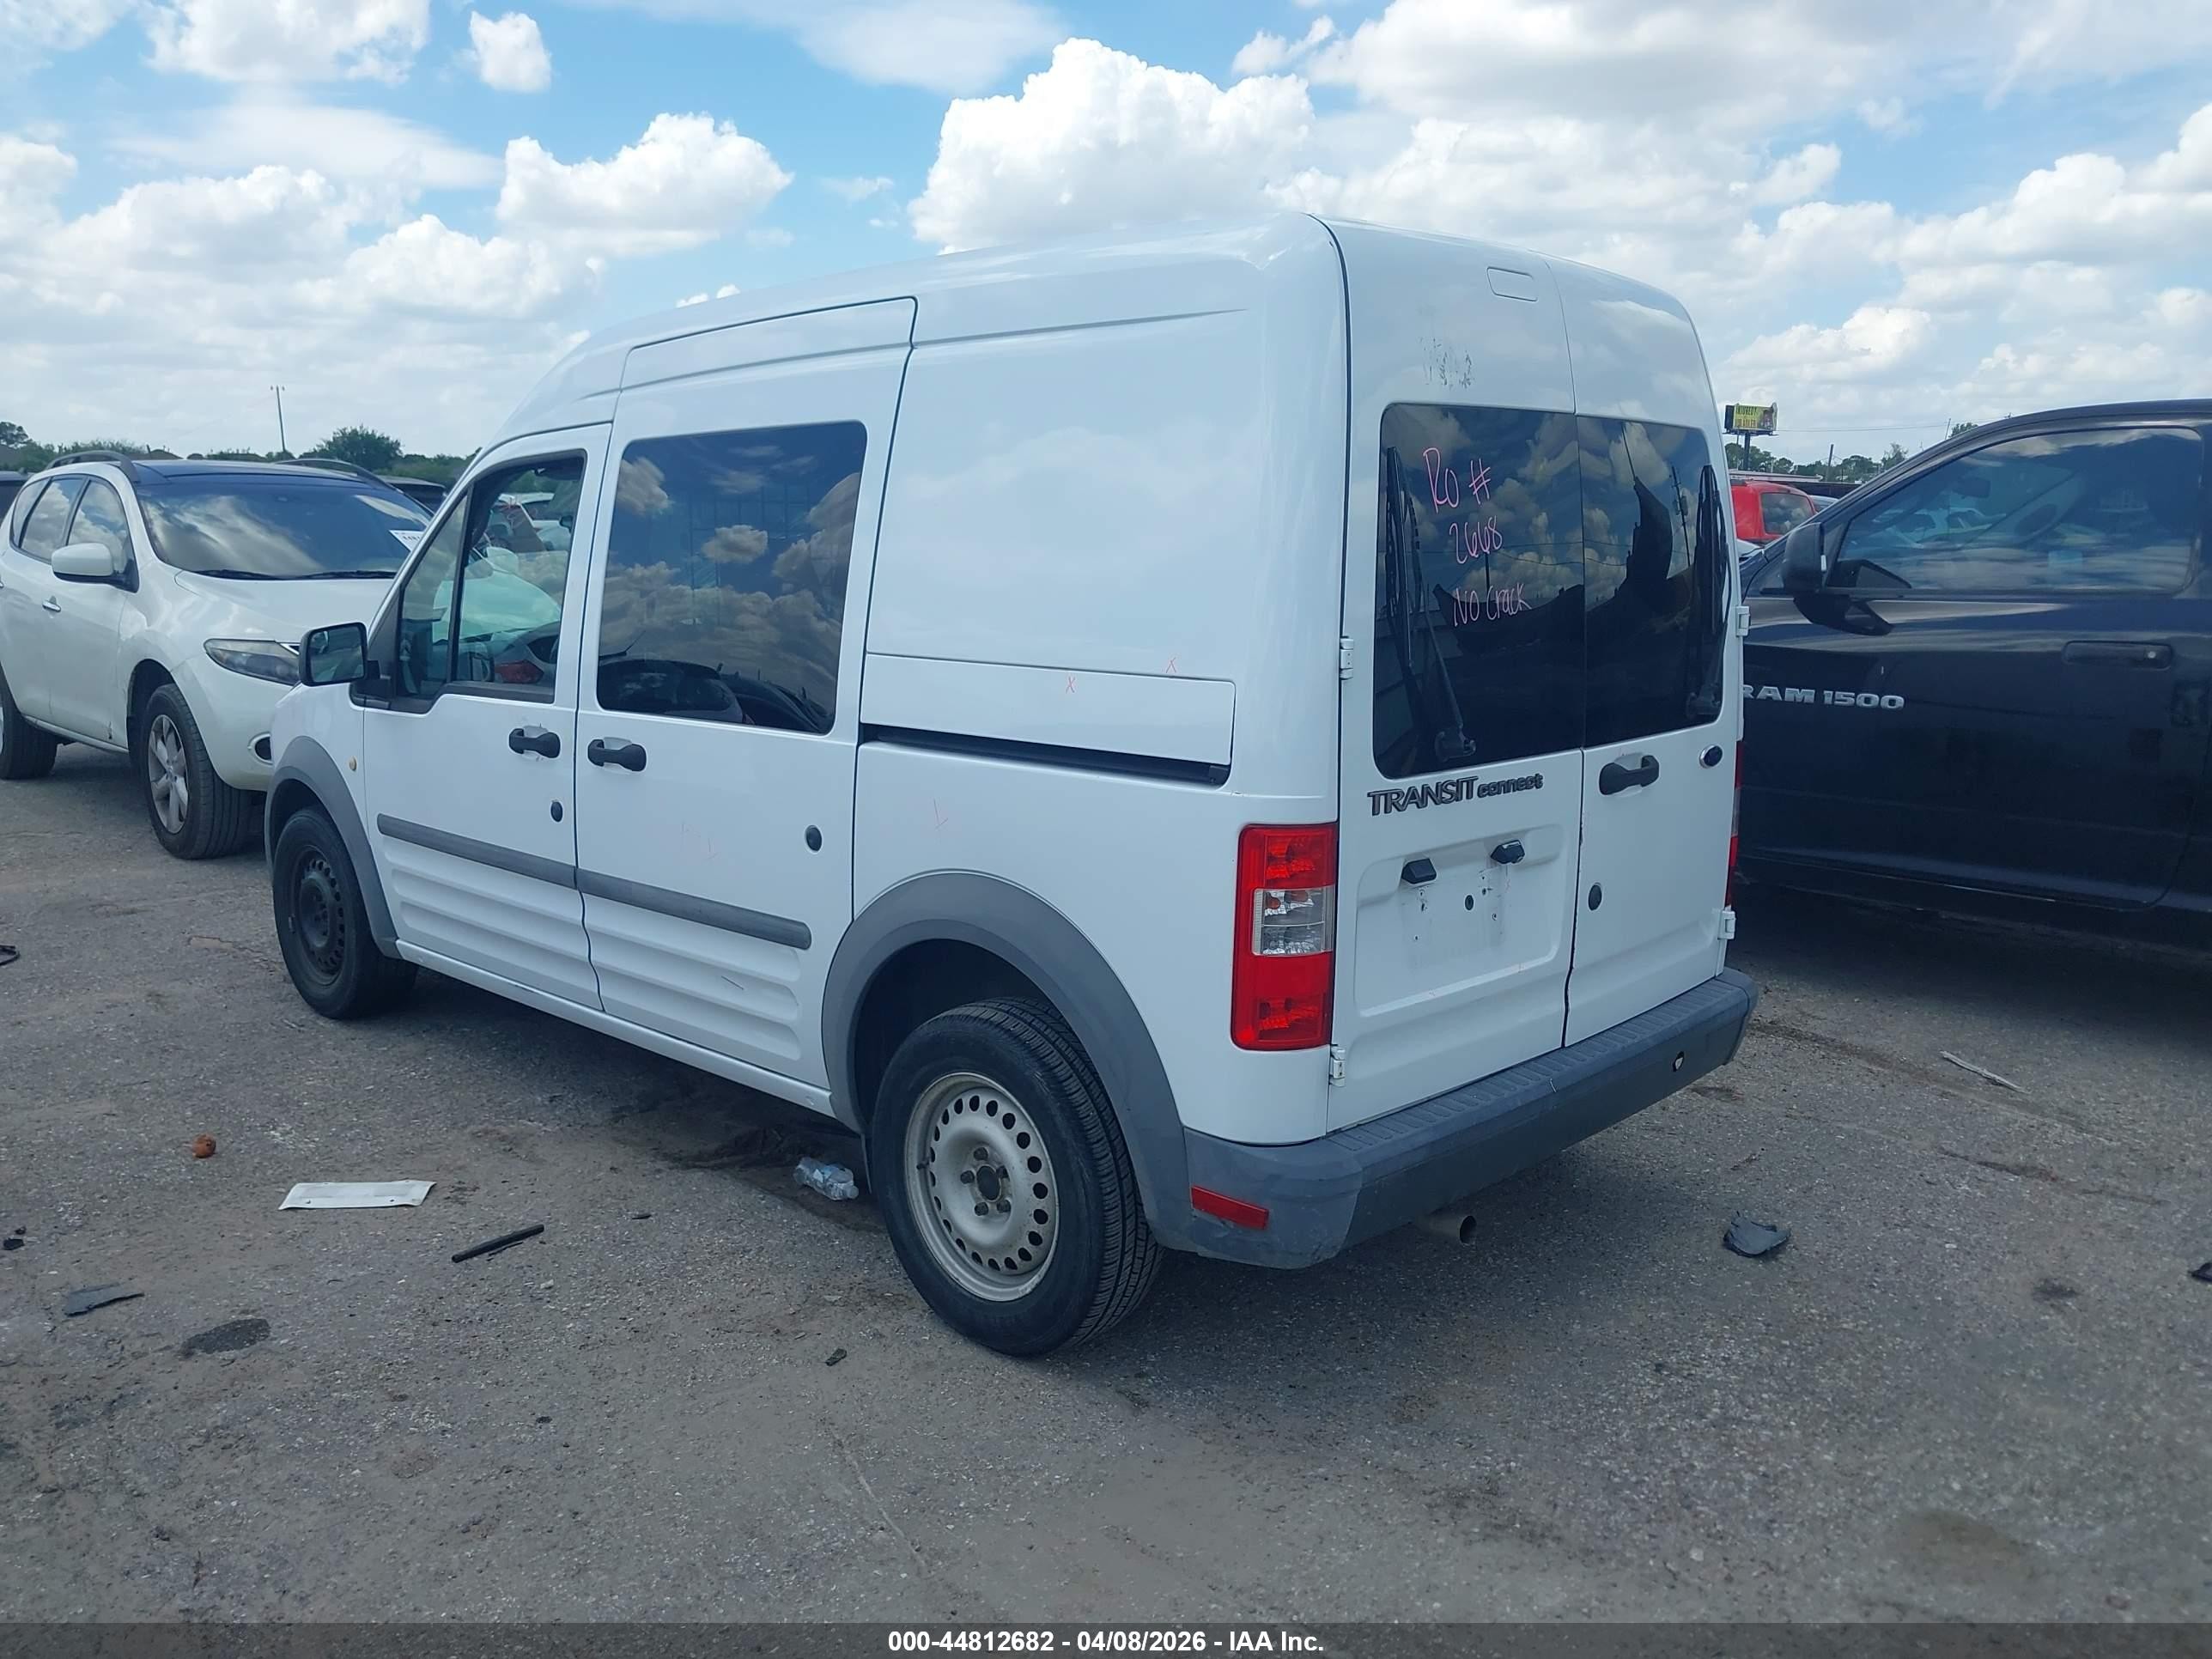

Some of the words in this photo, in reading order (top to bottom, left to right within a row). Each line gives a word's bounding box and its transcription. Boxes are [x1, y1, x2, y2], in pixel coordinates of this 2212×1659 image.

[1469, 458, 1492, 505] #
[1449, 515, 1503, 564] 2668
[1743, 684, 1815, 704] RAM
[1823, 690, 1905, 710] 1500
[1367, 775, 1479, 817] TRANSIT
[1477, 773, 1544, 799] connect
